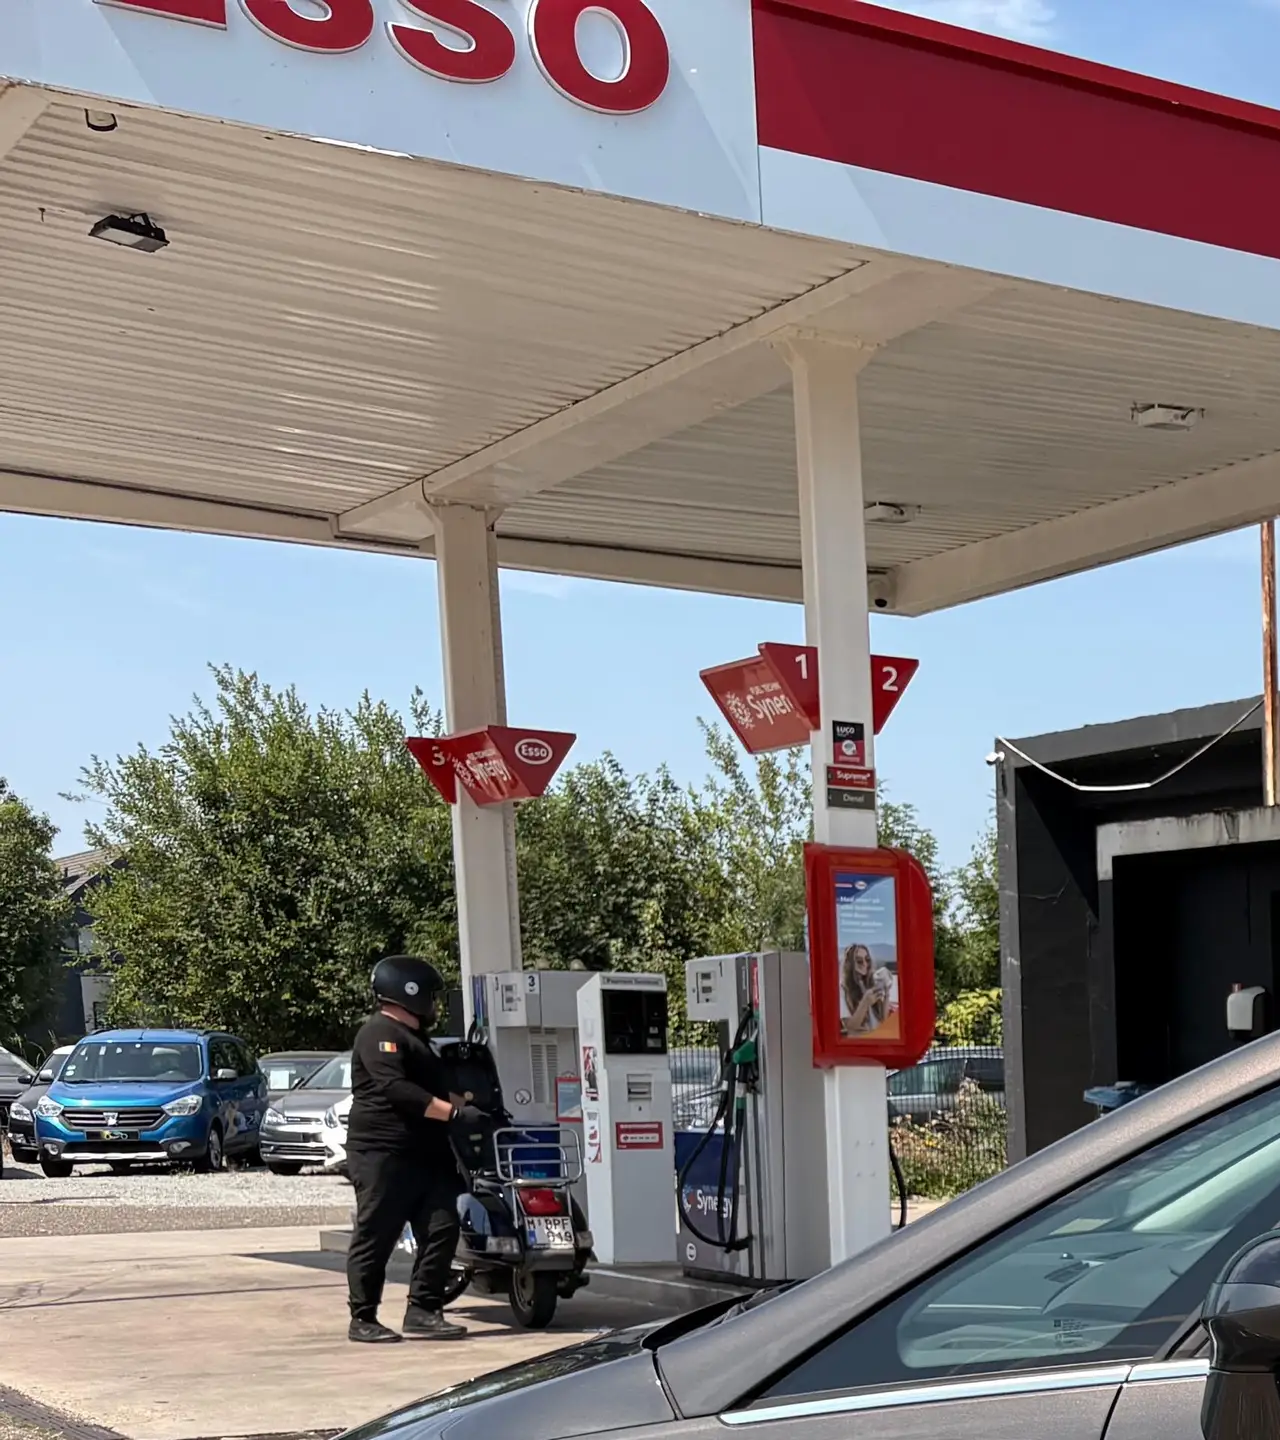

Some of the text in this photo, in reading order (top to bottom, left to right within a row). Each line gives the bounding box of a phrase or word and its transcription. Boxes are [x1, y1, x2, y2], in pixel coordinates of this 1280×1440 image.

[795, 653, 808, 680] 1
[882, 666, 899, 692] 2
[746, 693, 794, 725] Syner
[431, 745, 446, 767] 3
[521, 744, 547, 759] Esso
[528, 975, 535, 987] 3
[696, 1189, 733, 1219] Synegy
